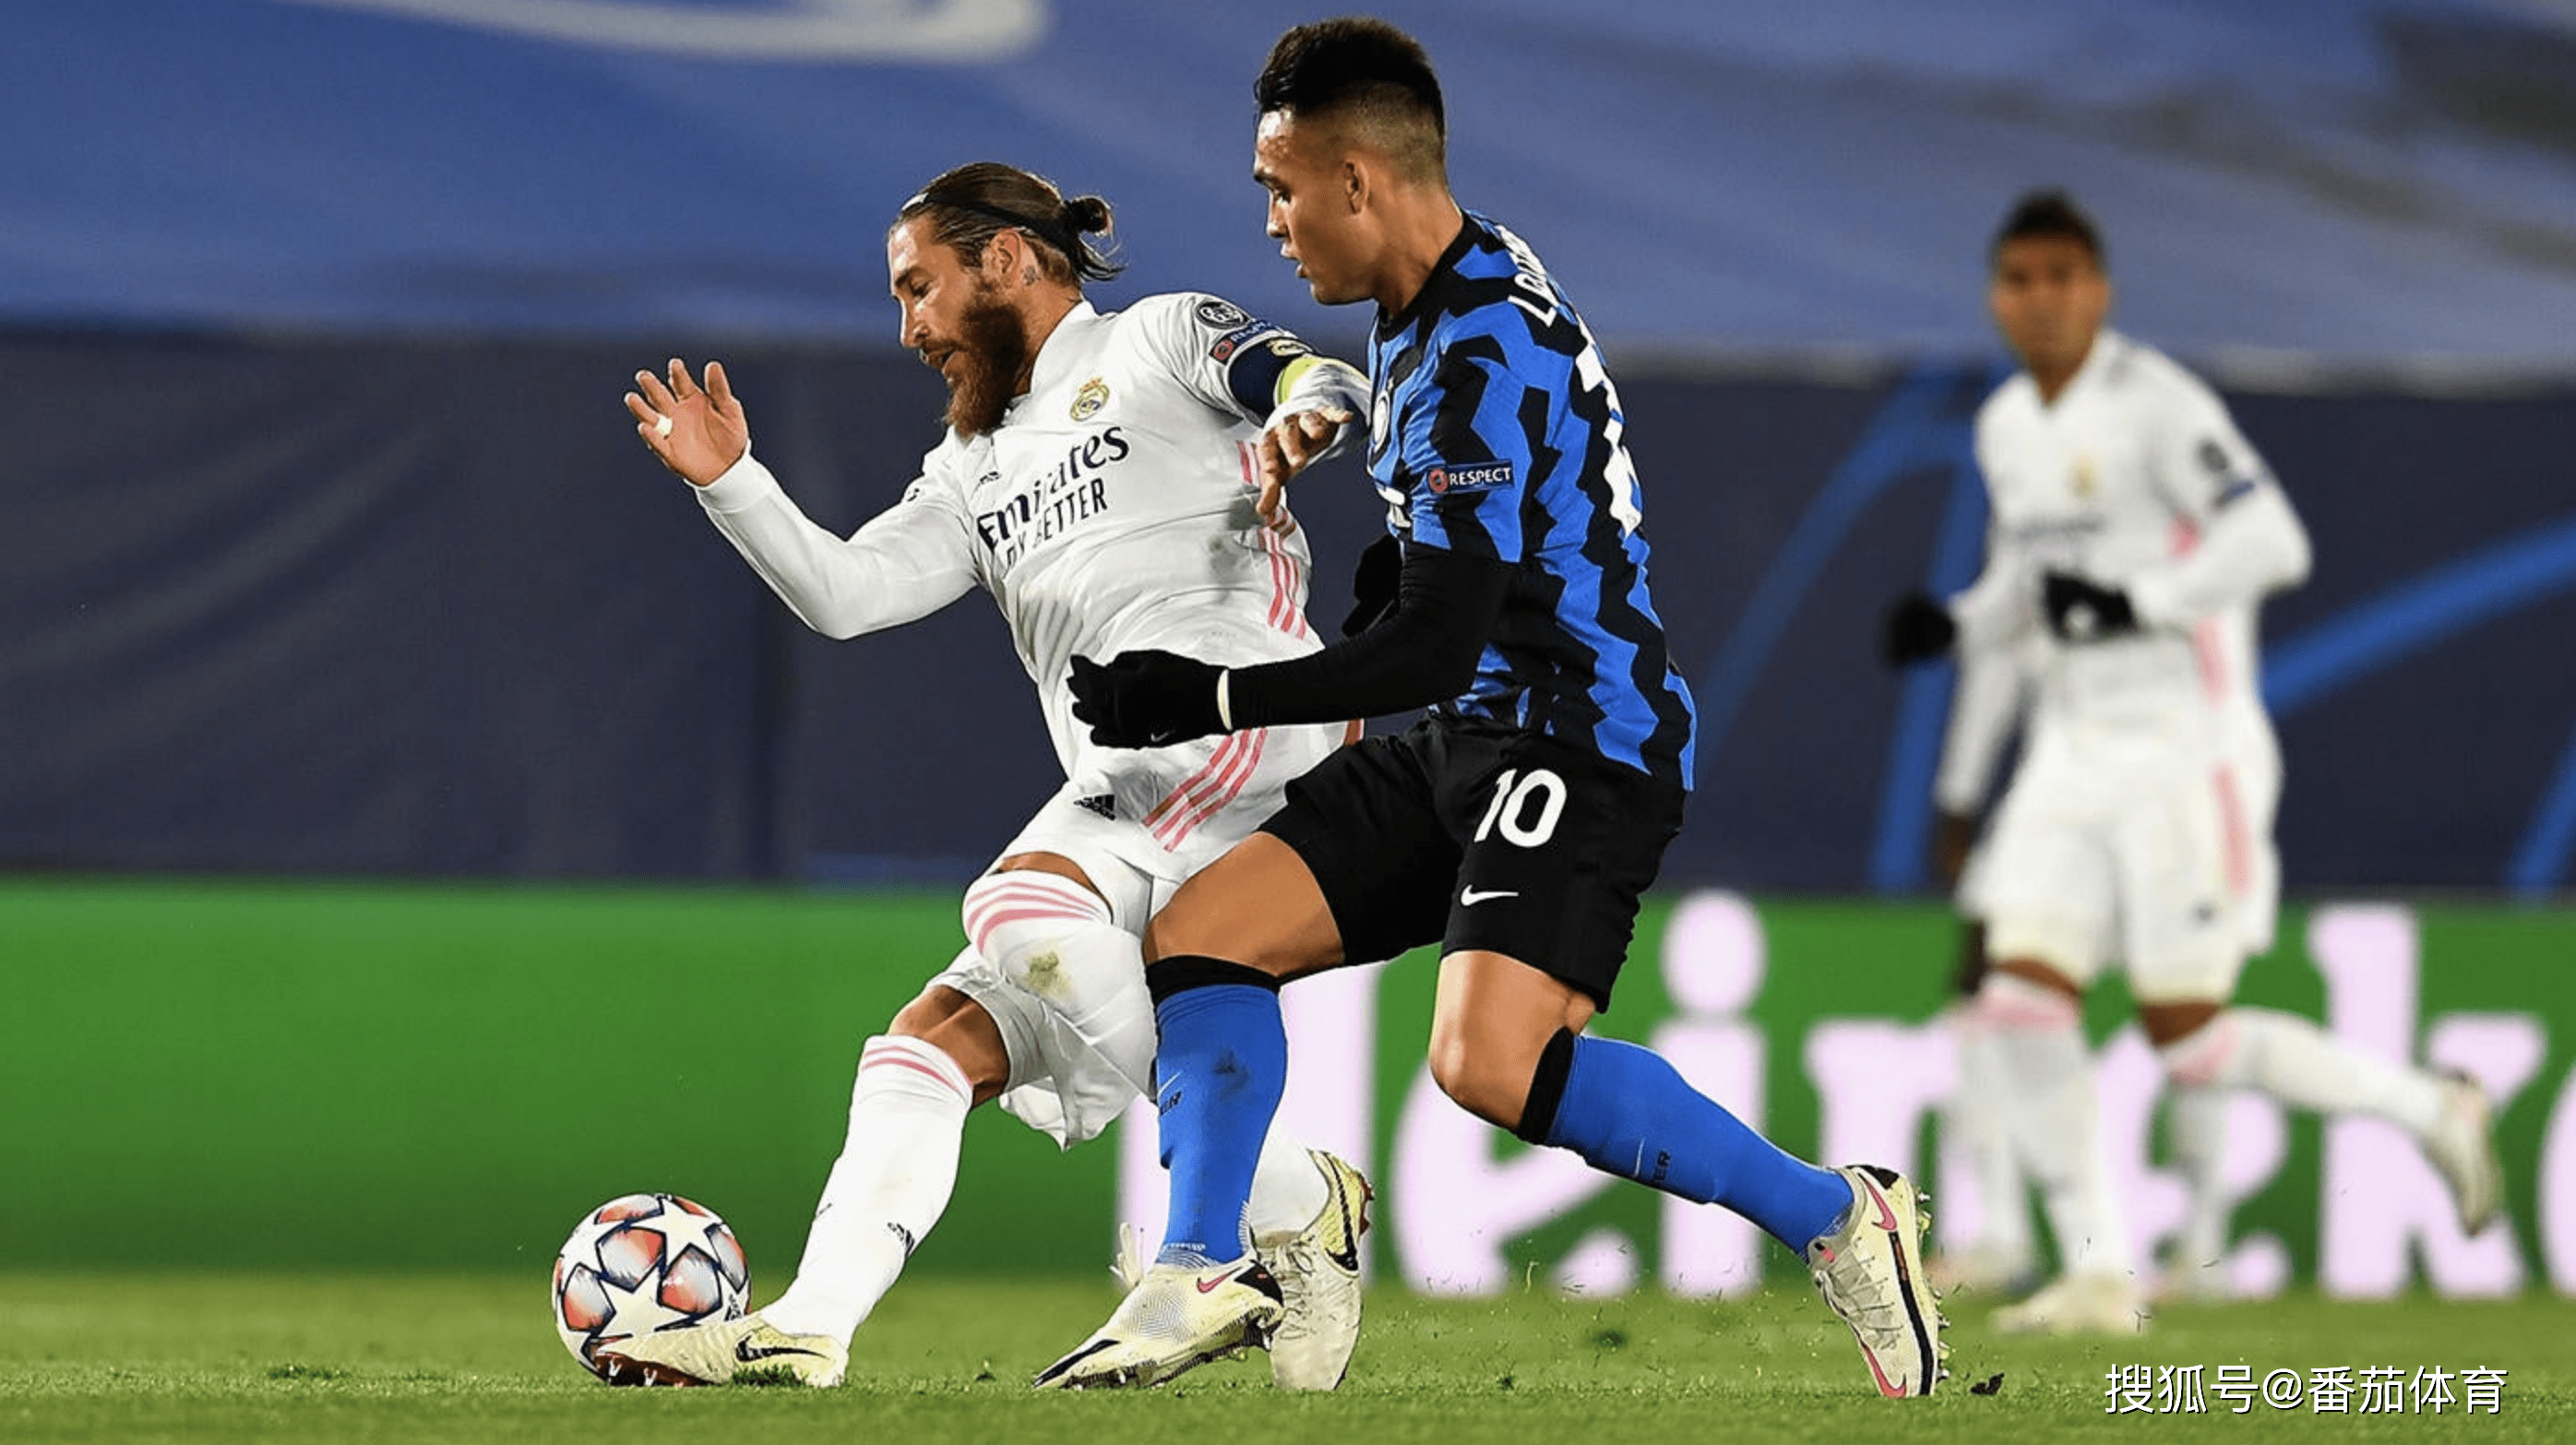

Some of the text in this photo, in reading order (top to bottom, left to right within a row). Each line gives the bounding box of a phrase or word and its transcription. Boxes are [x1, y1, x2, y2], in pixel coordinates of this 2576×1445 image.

[975, 425, 1130, 555] Emiates
[1449, 467, 1511, 486] RESPECT
[1473, 768, 1568, 848] 10
